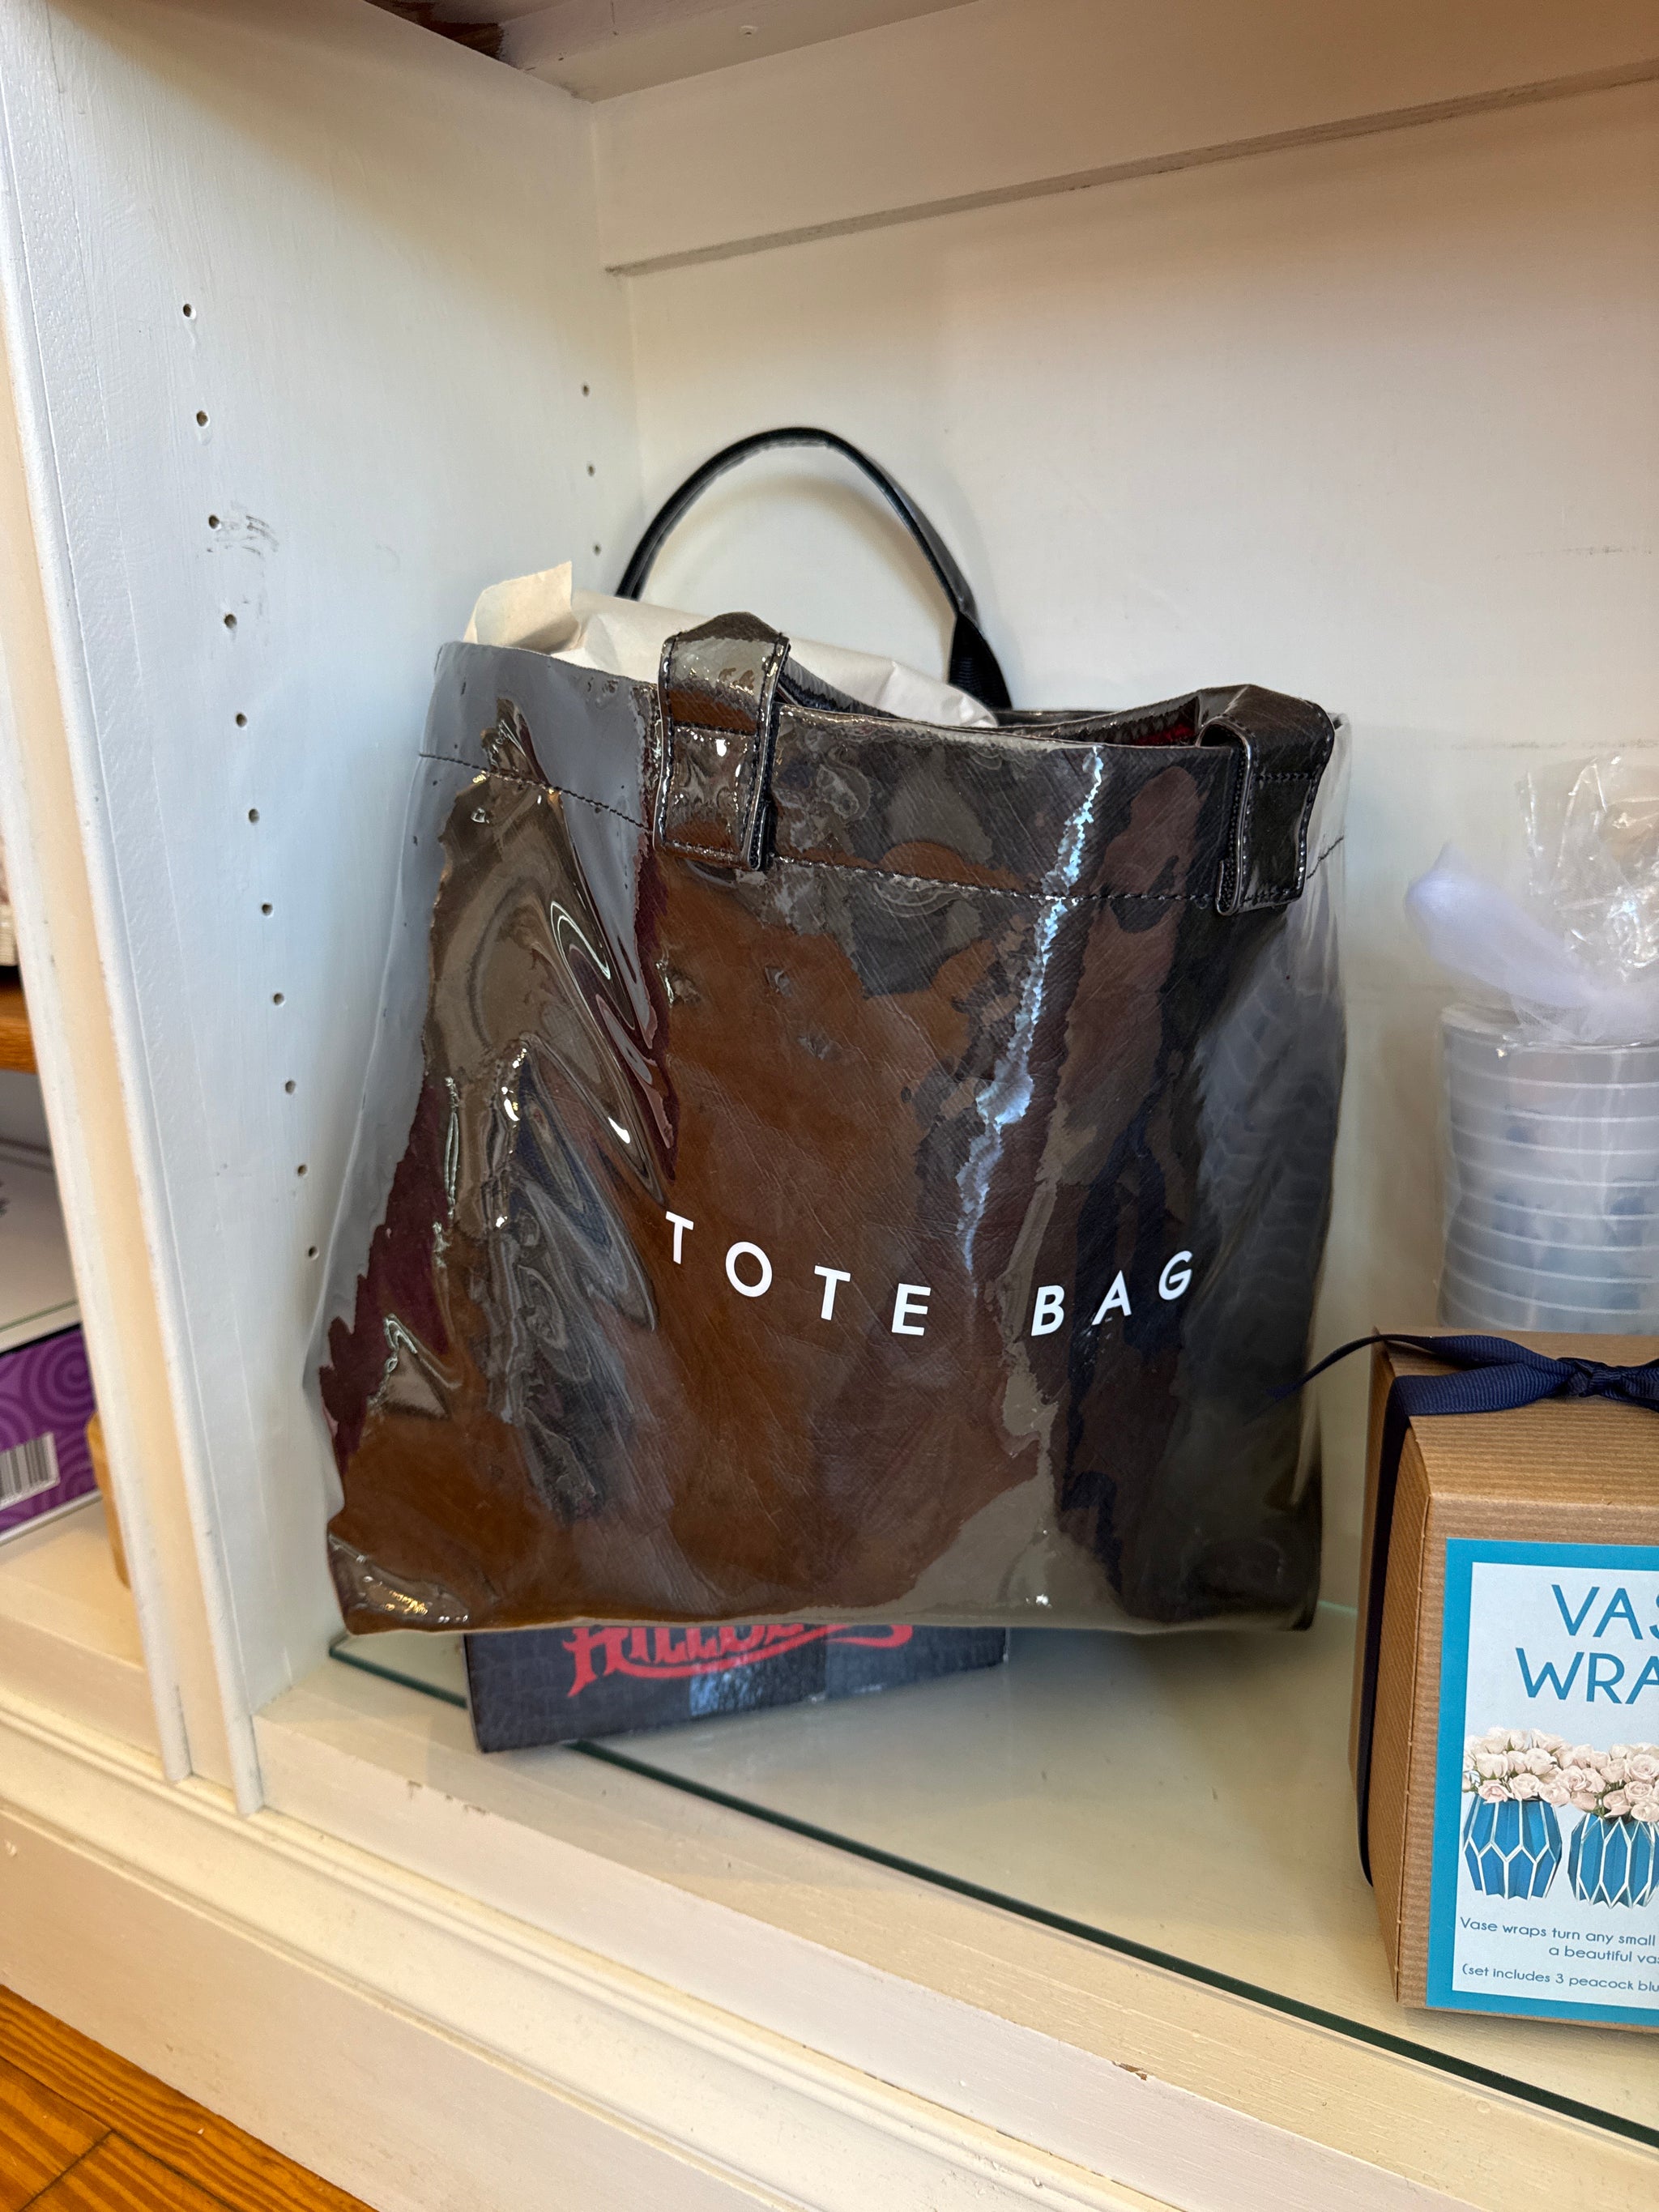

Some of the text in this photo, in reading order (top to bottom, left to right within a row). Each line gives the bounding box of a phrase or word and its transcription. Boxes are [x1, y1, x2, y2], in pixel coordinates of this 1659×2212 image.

[665, 1211, 1193, 1336] TOTE BAG
[1460, 1916, 1656, 1946] Vase wraps turn any small
[1548, 1946, 1559, 1956] a
[1564, 1946, 1632, 1962] beautiful
[1461, 1963, 1489, 1976] (set
[1492, 1968, 1550, 1983] includes
[1555, 1973, 1564, 1984] 3
[1569, 1975, 1634, 1991] peacock
